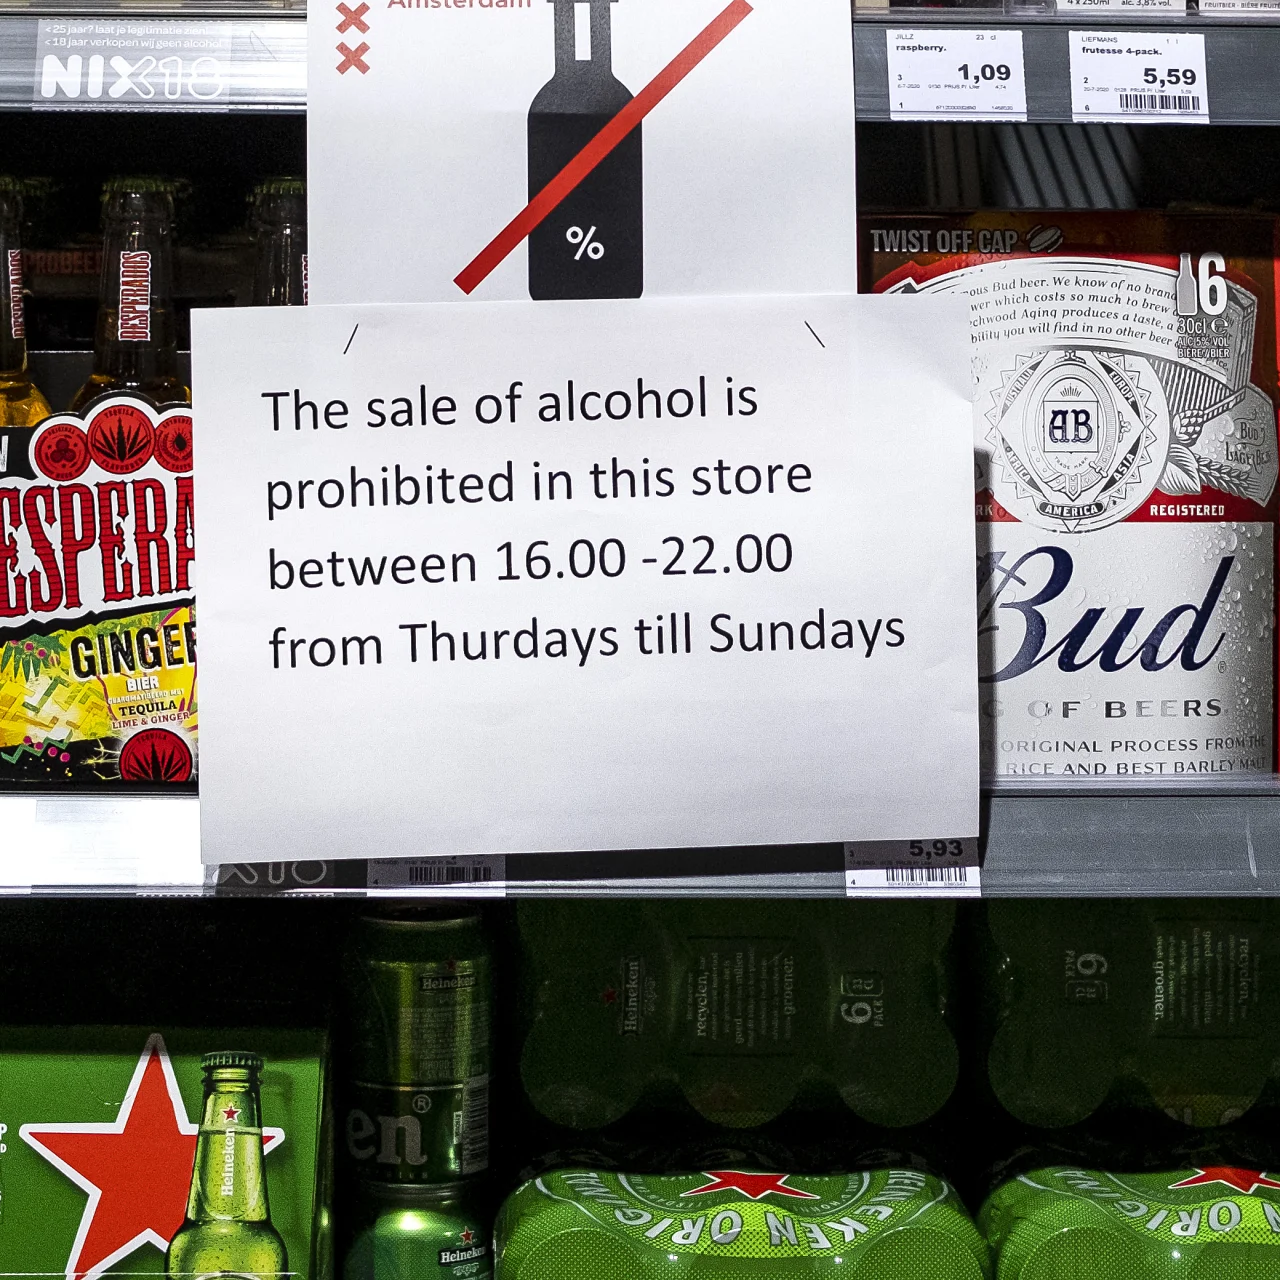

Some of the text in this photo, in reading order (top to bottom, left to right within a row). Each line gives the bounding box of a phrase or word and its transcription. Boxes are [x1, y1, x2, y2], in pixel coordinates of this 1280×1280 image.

[896, 44, 947, 53] raspberry.
[1082, 47, 1162, 56] frutesse 4-pack.
[41, 55, 223, 99] NIX18
[958, 63, 1011, 83] 1,09
[1144, 68, 1196, 87] 5,59
[871, 229, 1018, 253] TWIST OFF CAP
[262, 376, 758, 432] The sale of alcohol is
[266, 456, 812, 521] prohibited in this store
[1046, 504, 1099, 517] AMERICA
[1150, 504, 1224, 517] REGISTERED
[268, 532, 793, 590] between 16.00 -22.00
[978, 546, 1235, 683] Bud
[268, 607, 905, 670] from Thurdays till Sundays
[127, 677, 159, 692] BIER
[119, 701, 177, 717] TEQUILA
[1105, 699, 1222, 719] BEERS
[113, 711, 190, 729] LIME & GINGER
[1001, 739, 1198, 753] ORIGINAL PROCESS
[909, 838, 964, 861] 5,93
